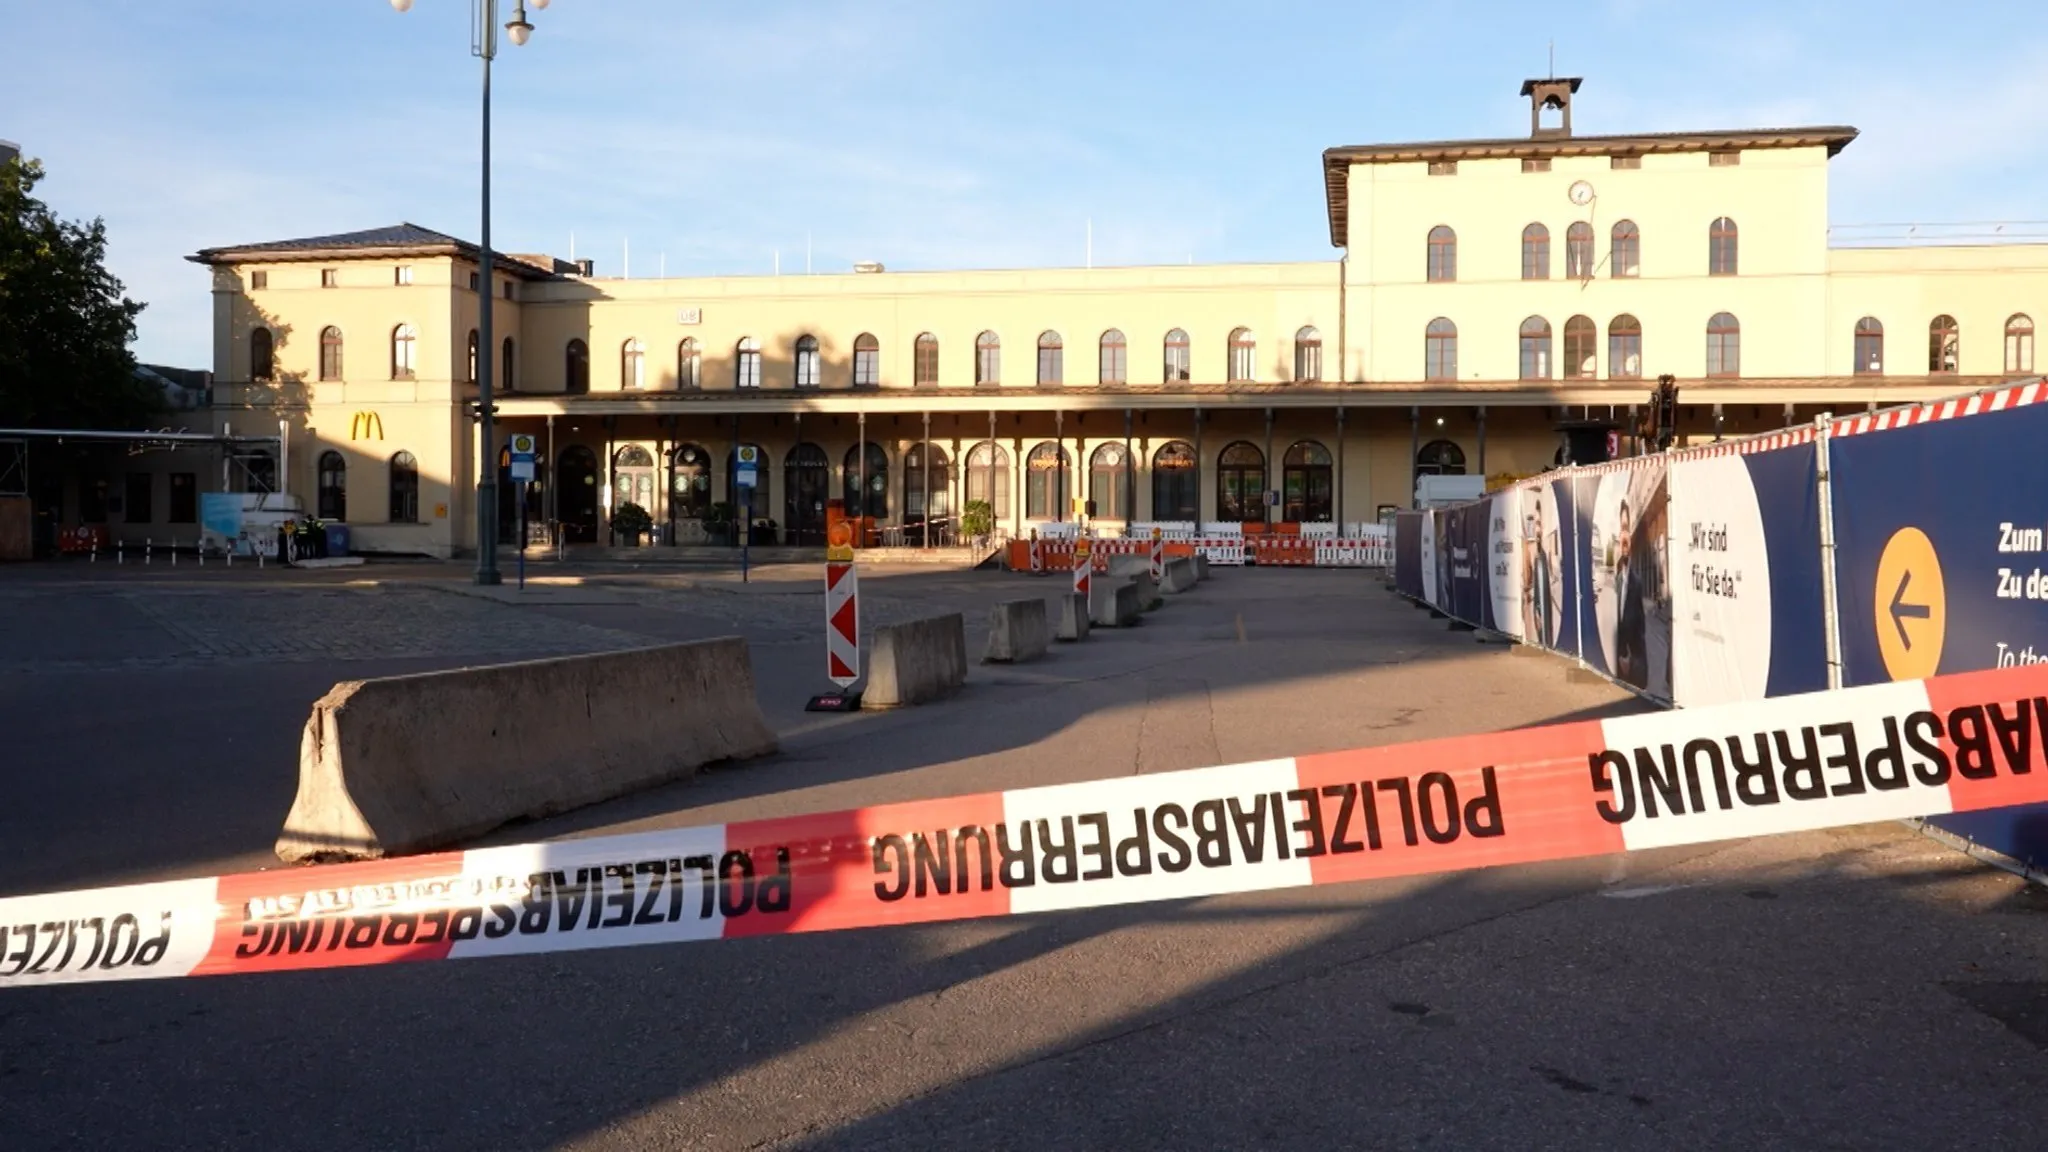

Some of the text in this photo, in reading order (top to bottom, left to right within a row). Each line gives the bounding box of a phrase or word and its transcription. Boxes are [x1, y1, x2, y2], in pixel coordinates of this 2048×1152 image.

[1708, 522, 1727, 551] sind
[1998, 522, 2042, 552] Zum
[1692, 563, 1704, 591] für
[1706, 565, 1720, 594] Sie
[1997, 568, 2021, 598] Zu
[872, 765, 1505, 902] POLIZEIABSPERRUNG
